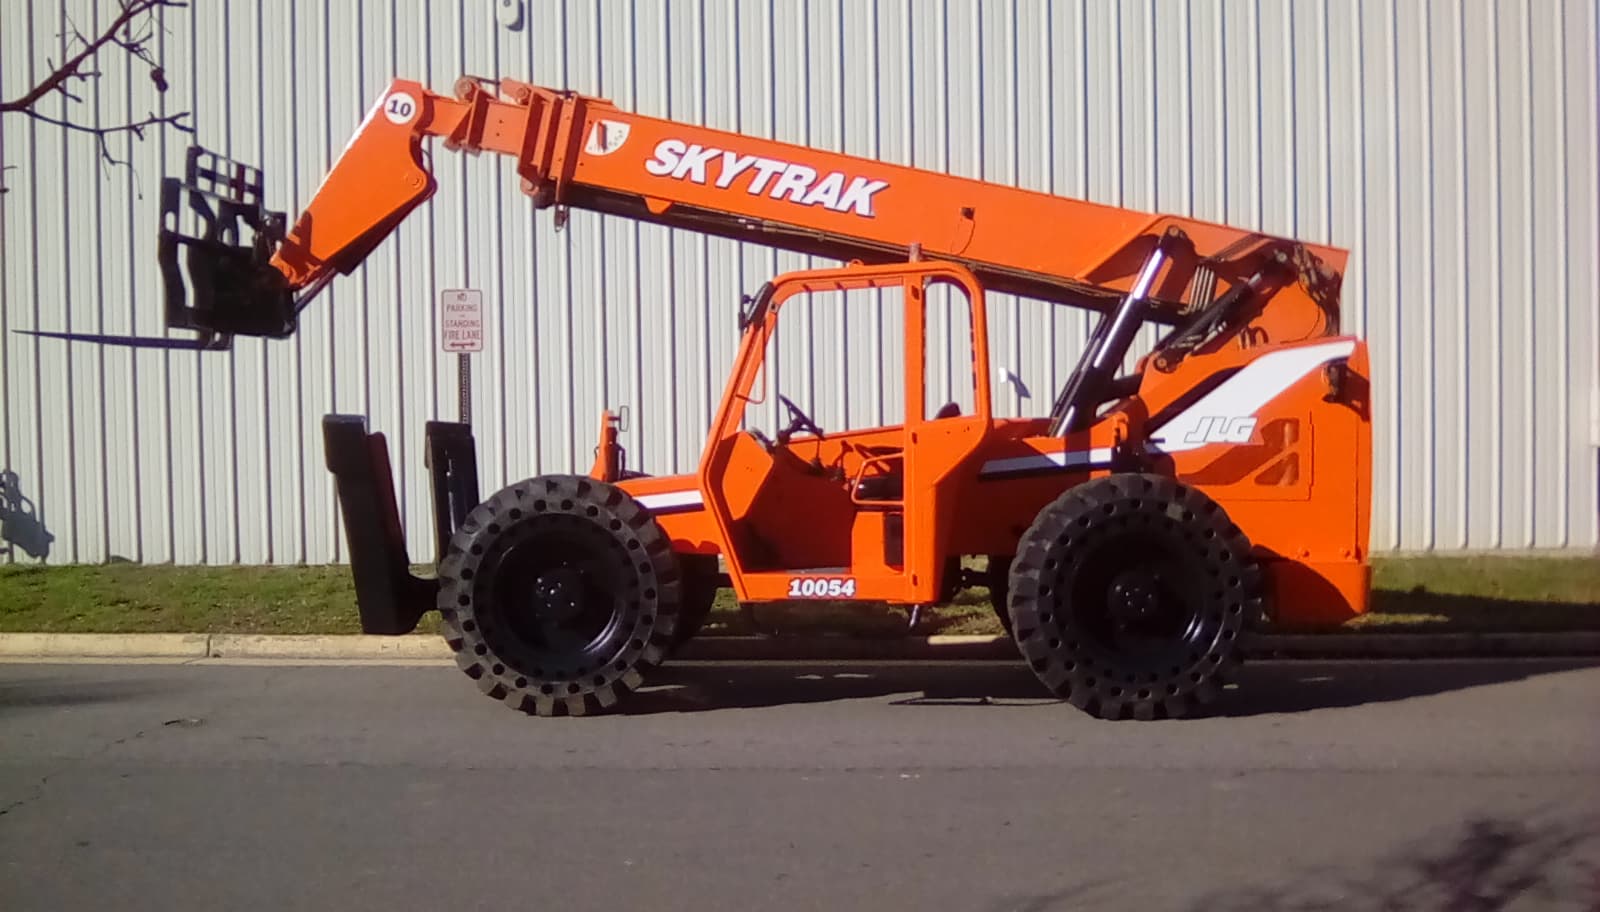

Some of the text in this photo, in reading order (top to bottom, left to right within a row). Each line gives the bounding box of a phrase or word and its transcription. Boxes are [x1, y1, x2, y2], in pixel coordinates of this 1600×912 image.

[388, 99, 411, 117] 10
[645, 139, 889, 217] SKYTRAK
[457, 293, 467, 301] NO
[446, 304, 478, 312] PARKING
[445, 320, 480, 328] STANDING
[444, 330, 480, 340] FIRE LANE
[1183, 416, 1259, 443] JLG
[788, 578, 855, 597] 10054
